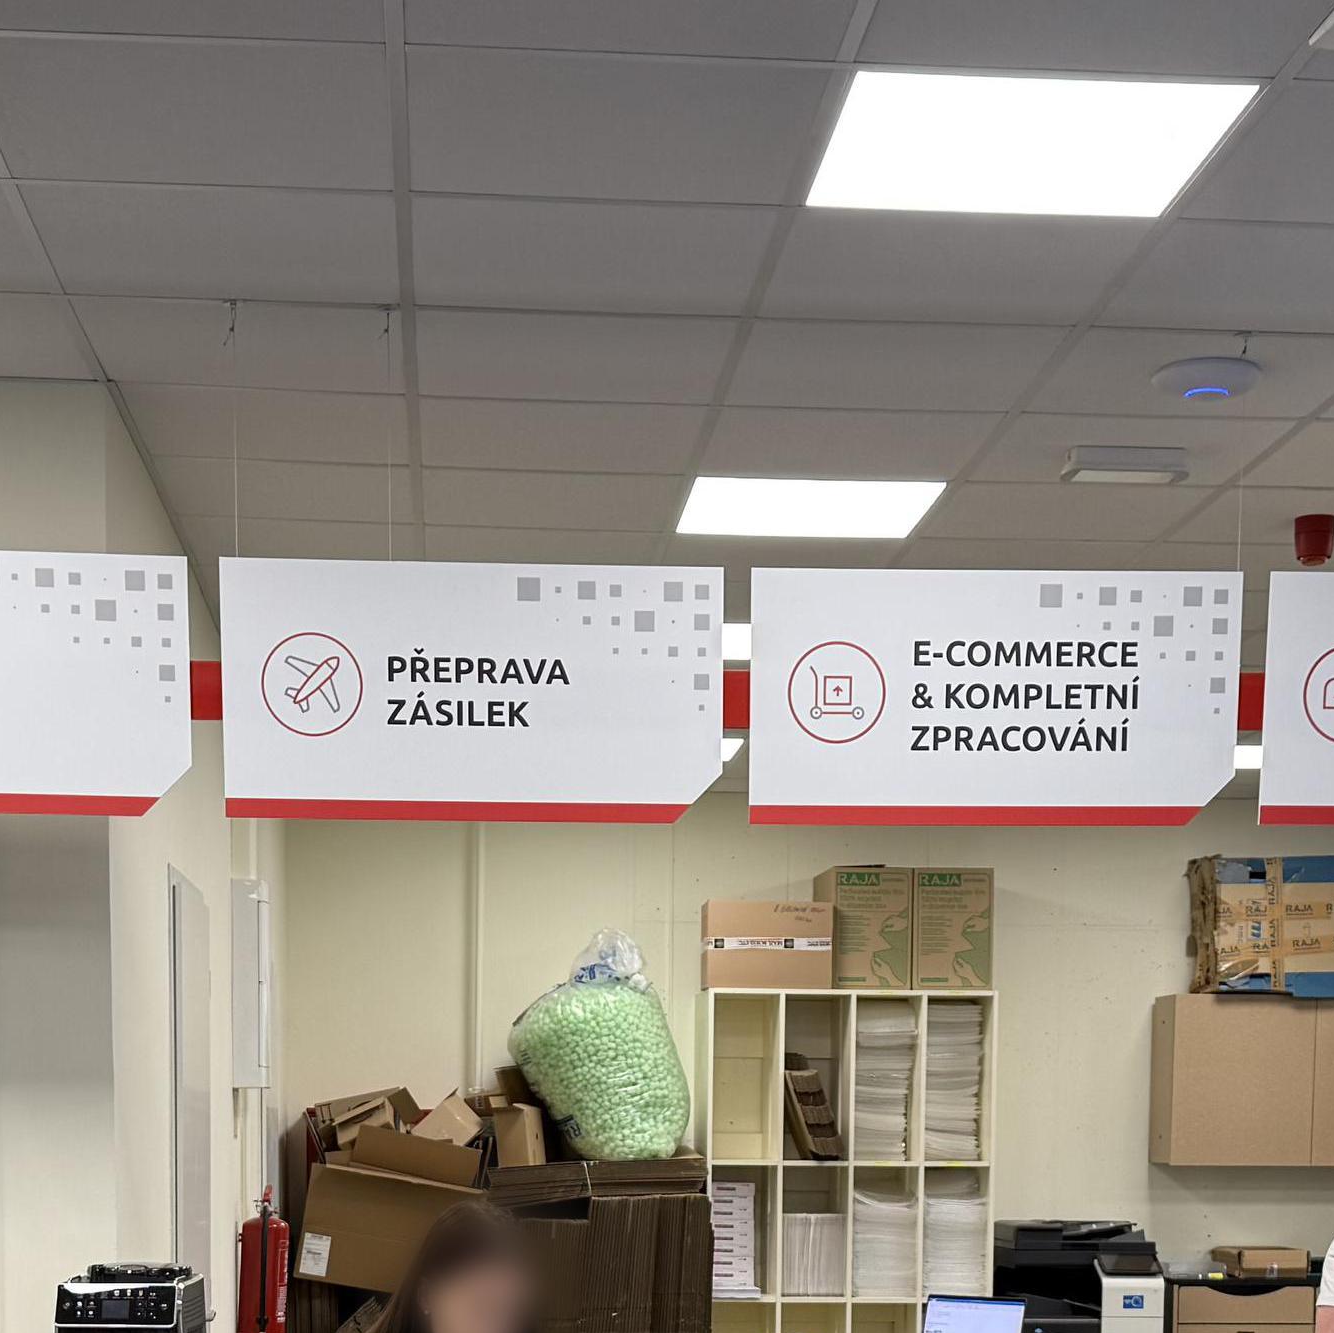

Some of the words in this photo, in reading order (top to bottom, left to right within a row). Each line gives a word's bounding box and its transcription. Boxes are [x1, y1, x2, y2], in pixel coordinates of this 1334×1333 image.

[387, 647, 571, 685] PŘEPRAVA
[913, 640, 1139, 668] E-COMMERCE
[911, 682, 935, 709] &
[945, 675, 1140, 710] KOMPLETNÍ
[386, 690, 530, 727] ZÁSILEK
[910, 717, 1130, 752] ZPRACOVÁNÍ
[838, 873, 879, 885] RAJA
[920, 874, 961, 886] RAJA
[1286, 904, 1314, 912] RAJA
[1292, 939, 1321, 948] RAJA
